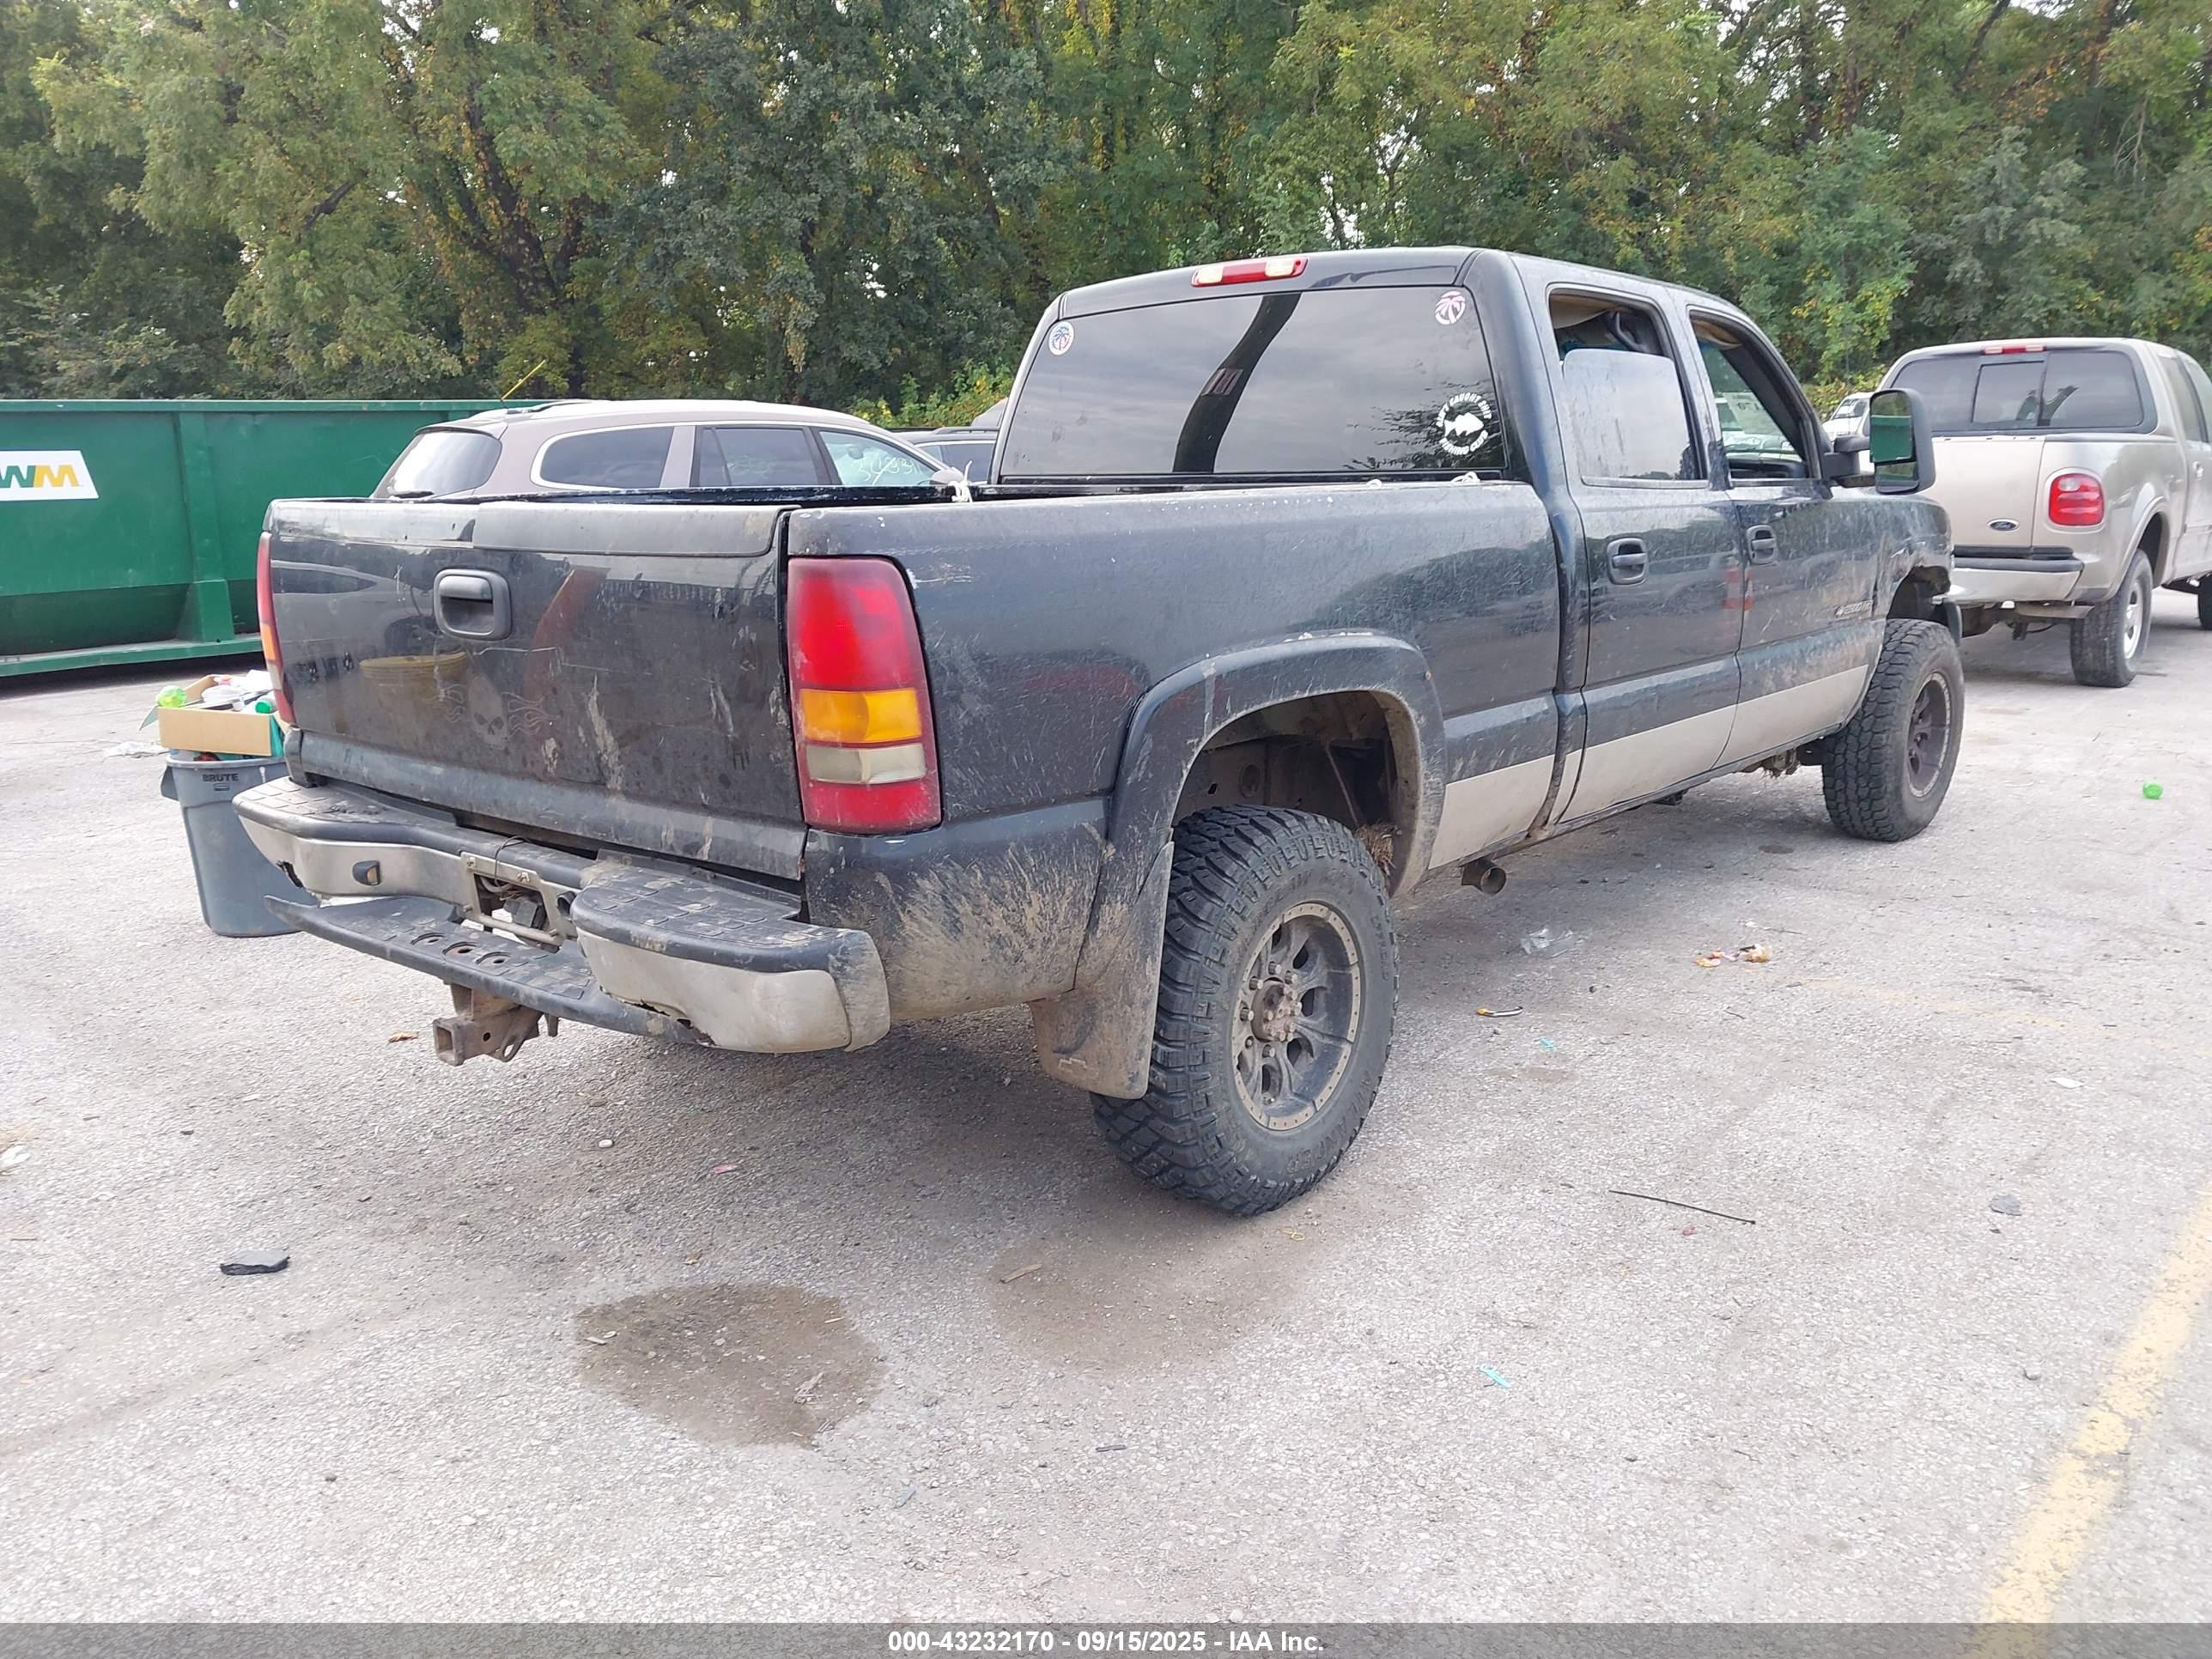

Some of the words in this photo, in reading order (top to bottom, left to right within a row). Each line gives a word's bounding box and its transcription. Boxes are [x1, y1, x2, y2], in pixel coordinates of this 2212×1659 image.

[1470, 429, 1489, 452] CLUB
[0, 465, 80, 489] WM
[202, 773, 240, 782] BRUTE
